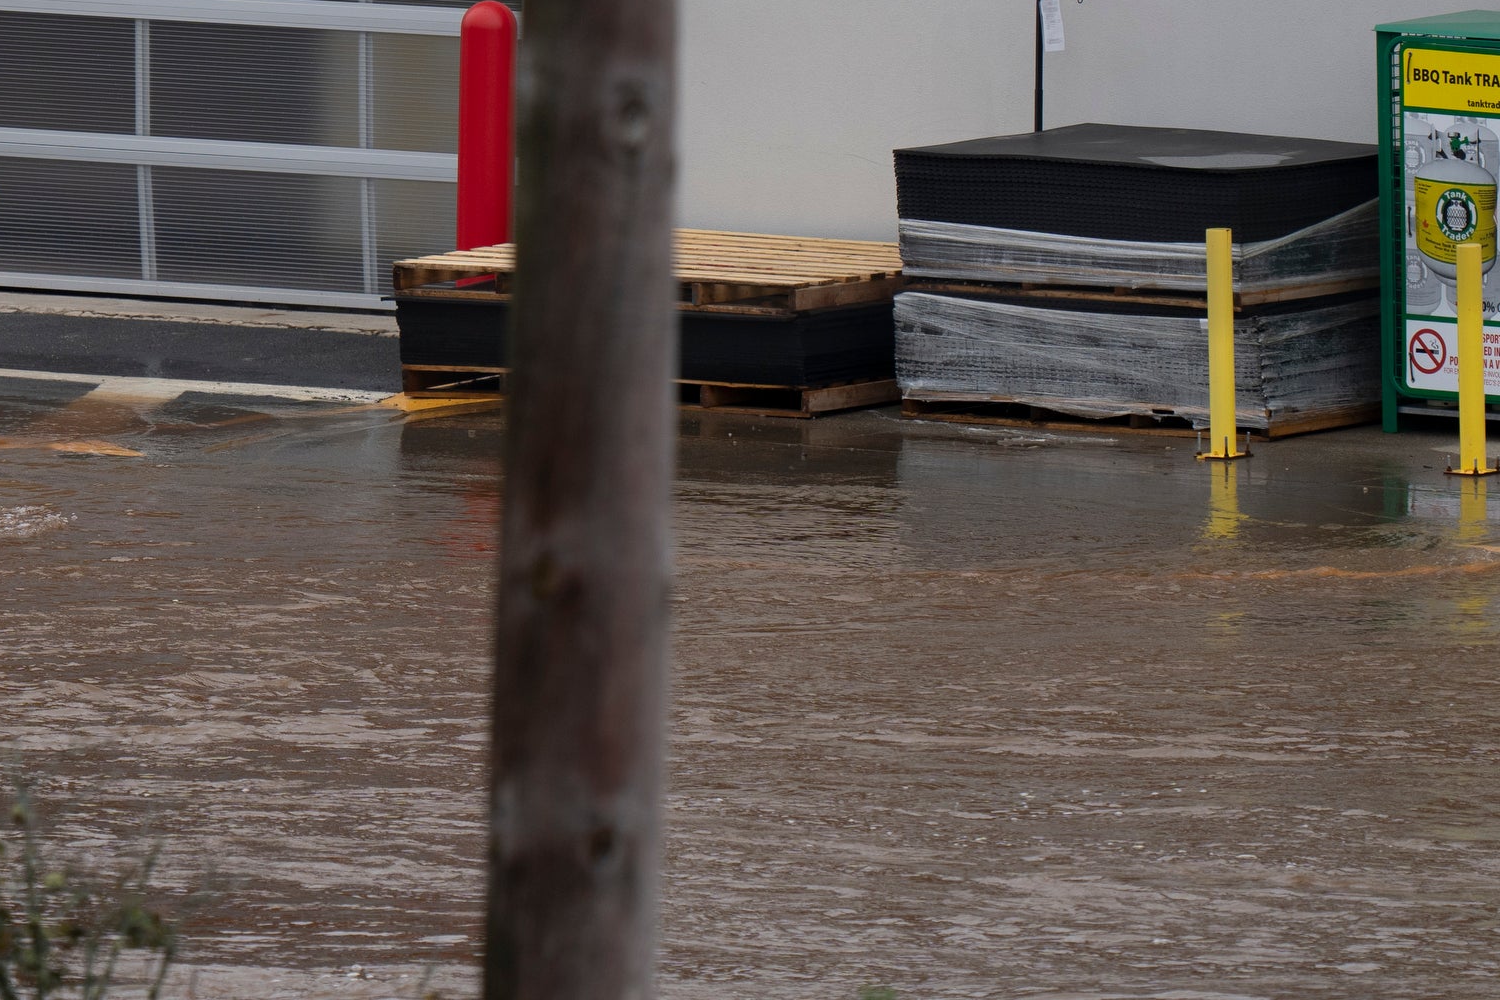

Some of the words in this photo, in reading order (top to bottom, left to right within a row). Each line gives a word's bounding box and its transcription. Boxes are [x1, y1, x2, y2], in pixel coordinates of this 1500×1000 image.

[1413, 68, 1440, 85] BBQ
[1442, 70, 1472, 86] Tank
[1444, 191, 1467, 202] Tank
[1441, 224, 1475, 241] Traders
